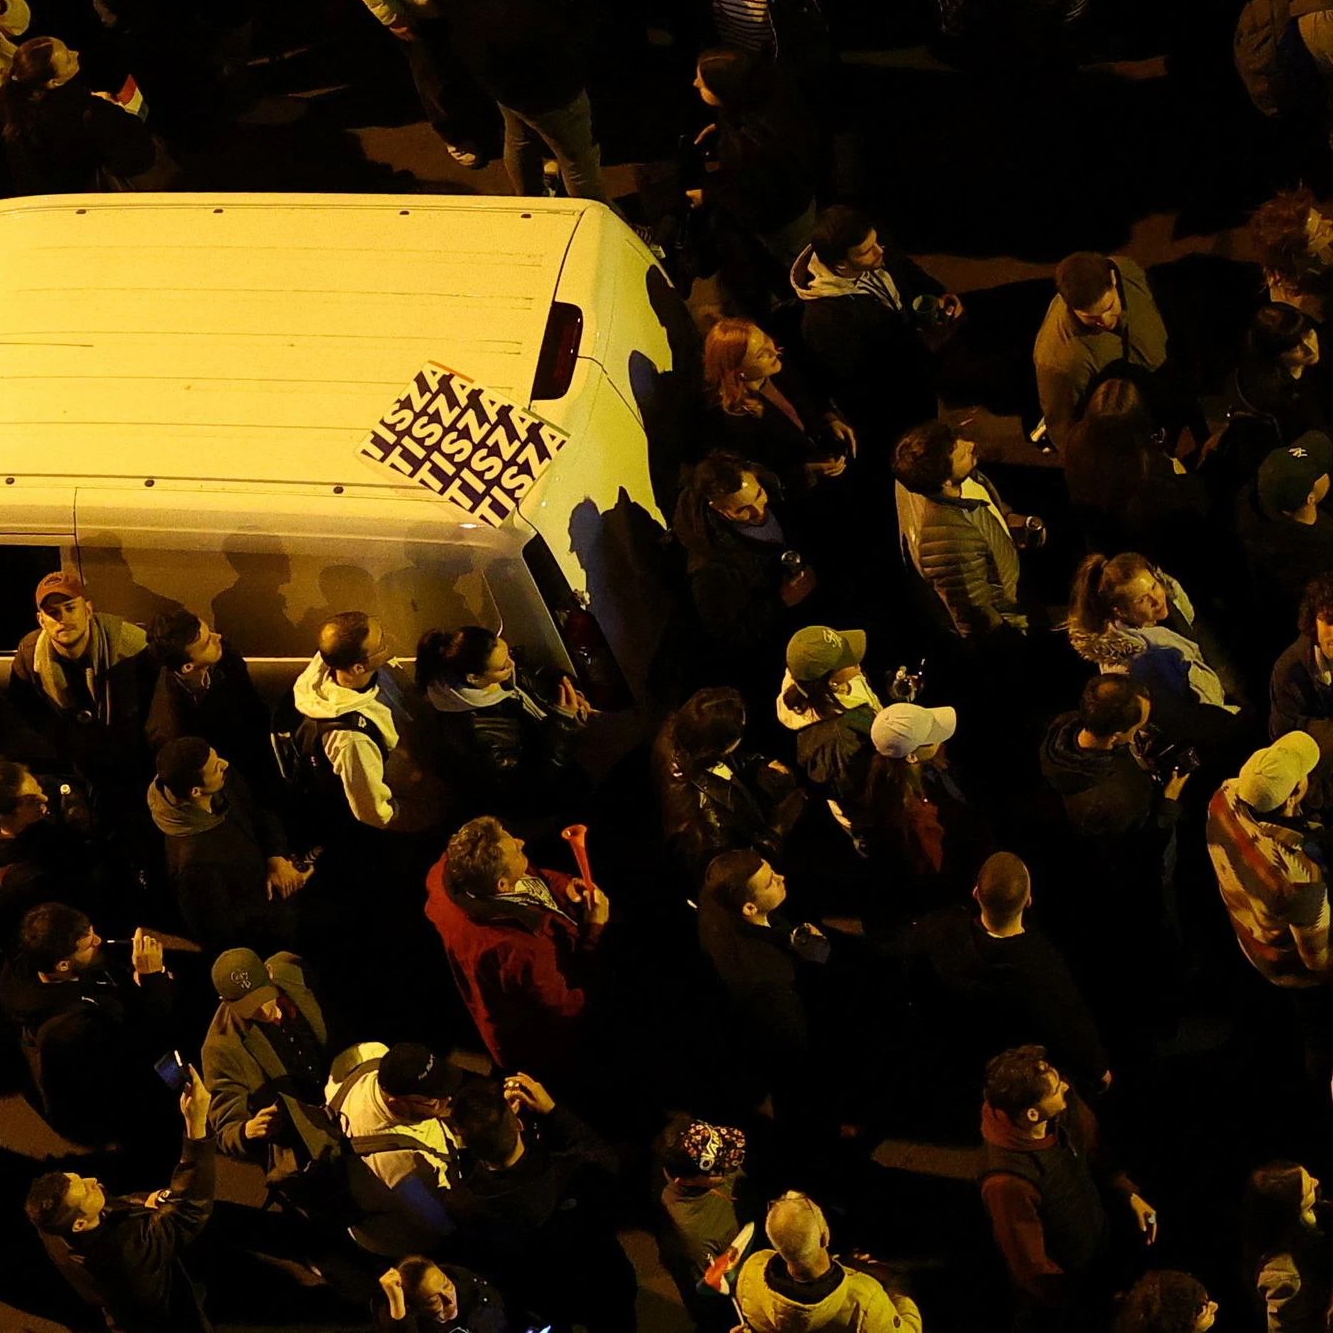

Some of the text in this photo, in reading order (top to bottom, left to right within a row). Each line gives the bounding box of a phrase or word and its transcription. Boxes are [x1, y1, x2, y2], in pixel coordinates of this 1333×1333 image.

[358, 366, 449, 461] TISZA
[384, 376, 476, 476] TISZA
[414, 391, 507, 494] TISZA
[444, 408, 539, 511] TISZA
[475, 425, 567, 528] TISZA
